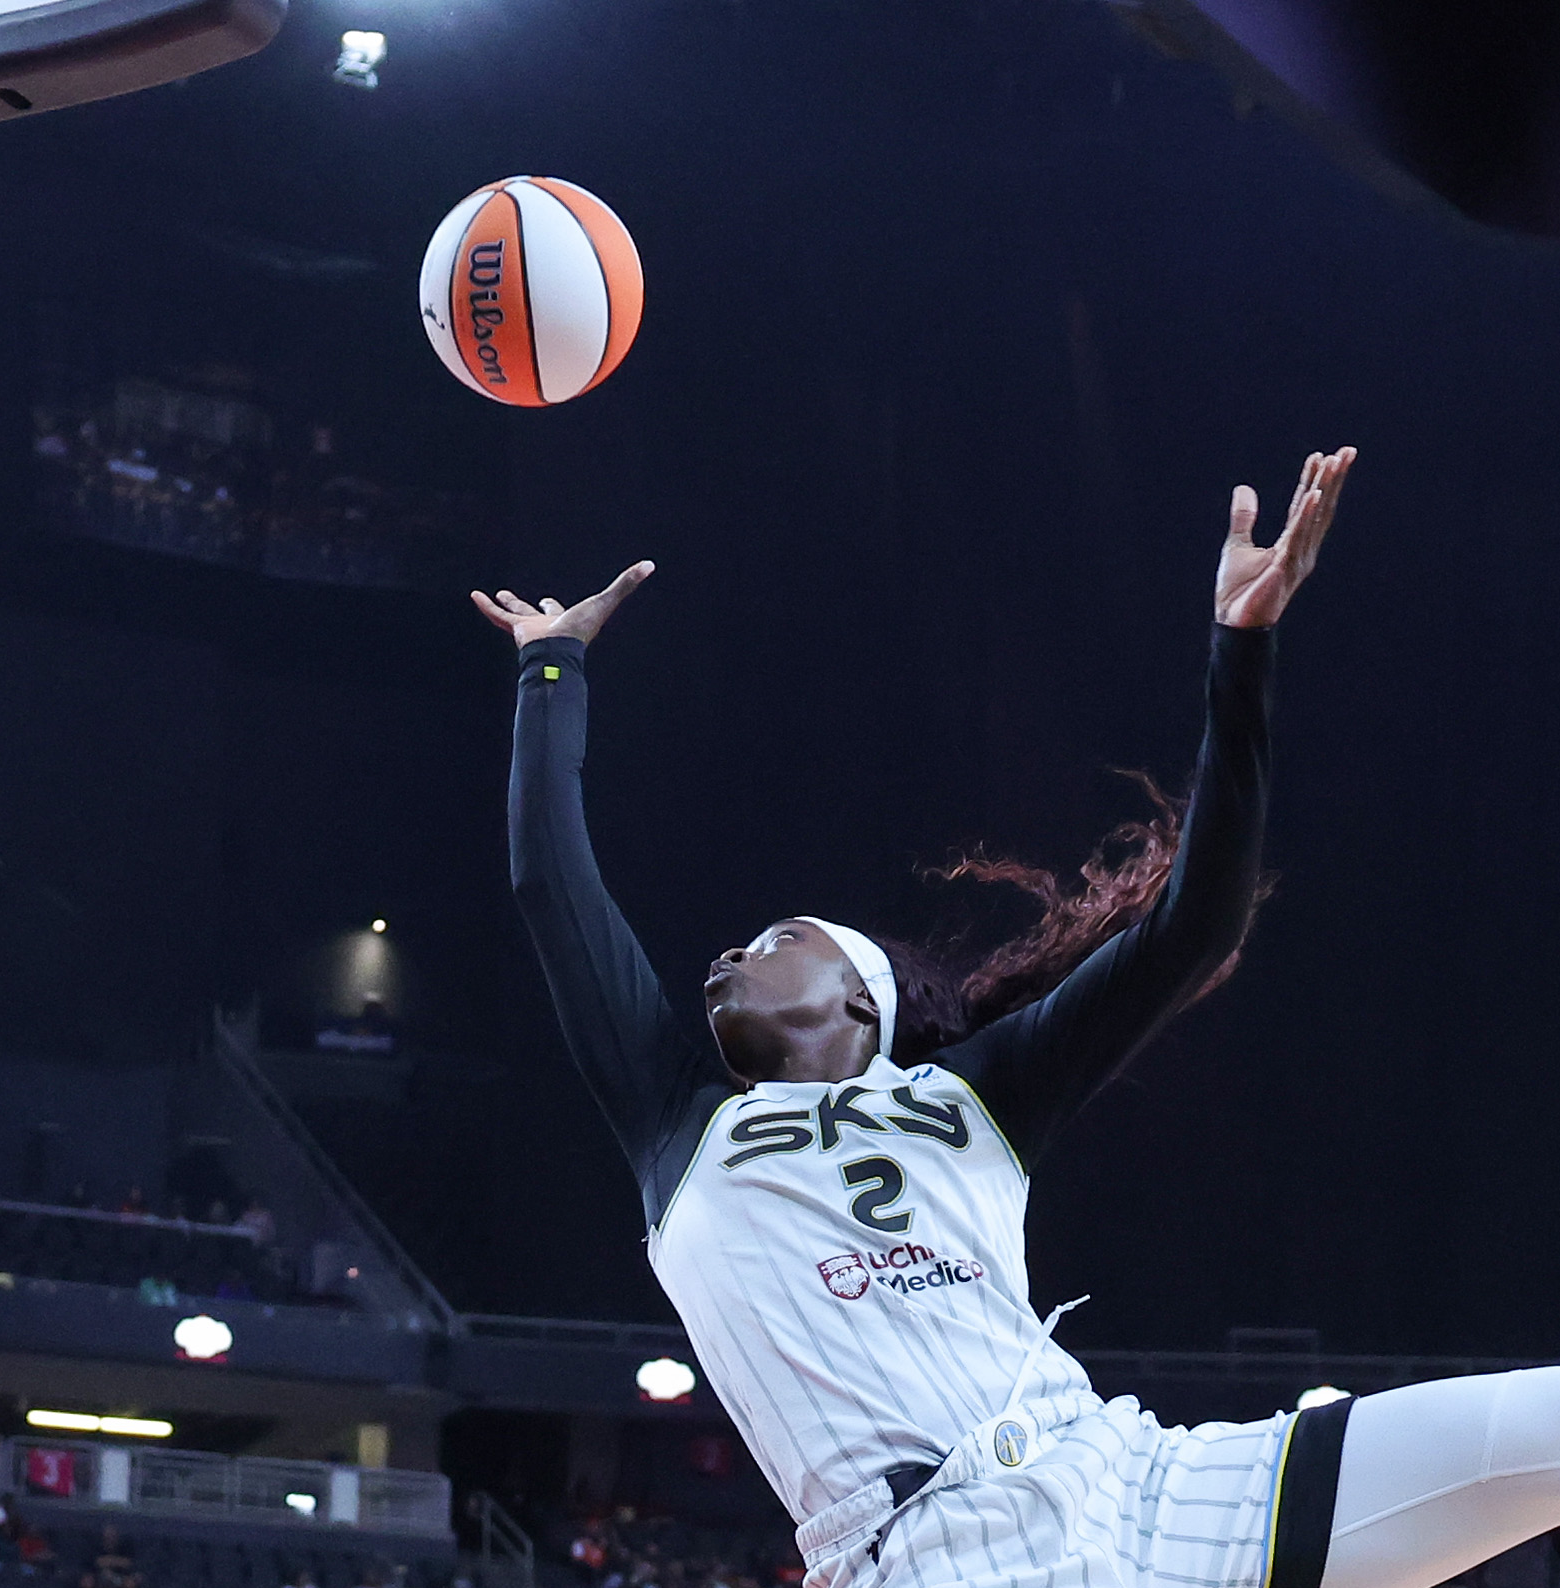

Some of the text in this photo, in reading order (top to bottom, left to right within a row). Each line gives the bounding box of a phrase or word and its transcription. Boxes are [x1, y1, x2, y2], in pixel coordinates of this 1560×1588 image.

[467, 238, 509, 385] Wilson
[718, 1085, 972, 1171] SKY
[839, 1154, 915, 1235] 2
